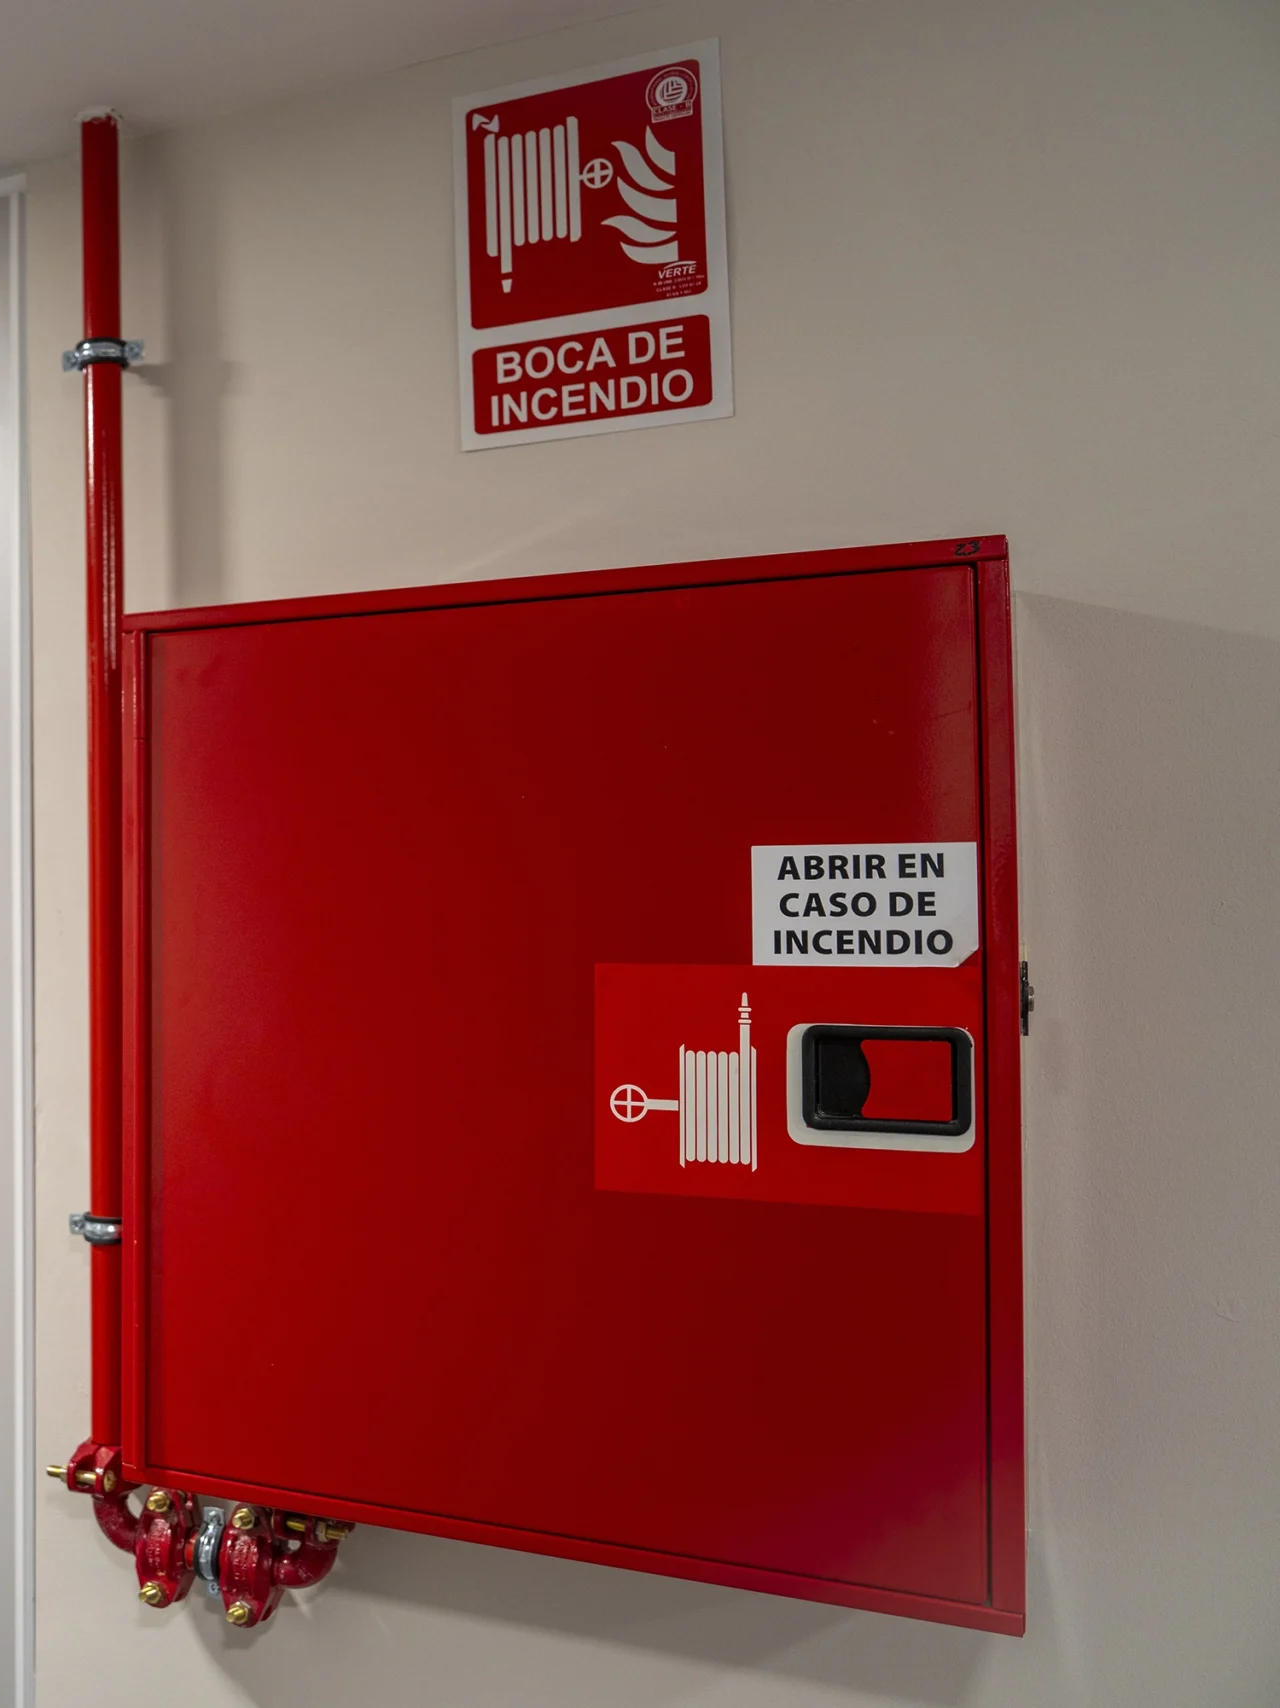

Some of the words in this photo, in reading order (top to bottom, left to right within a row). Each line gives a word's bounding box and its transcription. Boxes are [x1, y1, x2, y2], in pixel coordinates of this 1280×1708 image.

[658, 264, 697, 279] VERTE
[496, 337, 616, 384] BOCA
[628, 325, 685, 365] DE
[490, 368, 694, 427] INCENDIO
[777, 854, 887, 880] ABRIR
[898, 852, 945, 879] EN
[779, 891, 877, 918] CASO
[889, 891, 937, 917] DE
[773, 929, 954, 955] INCENDIO
